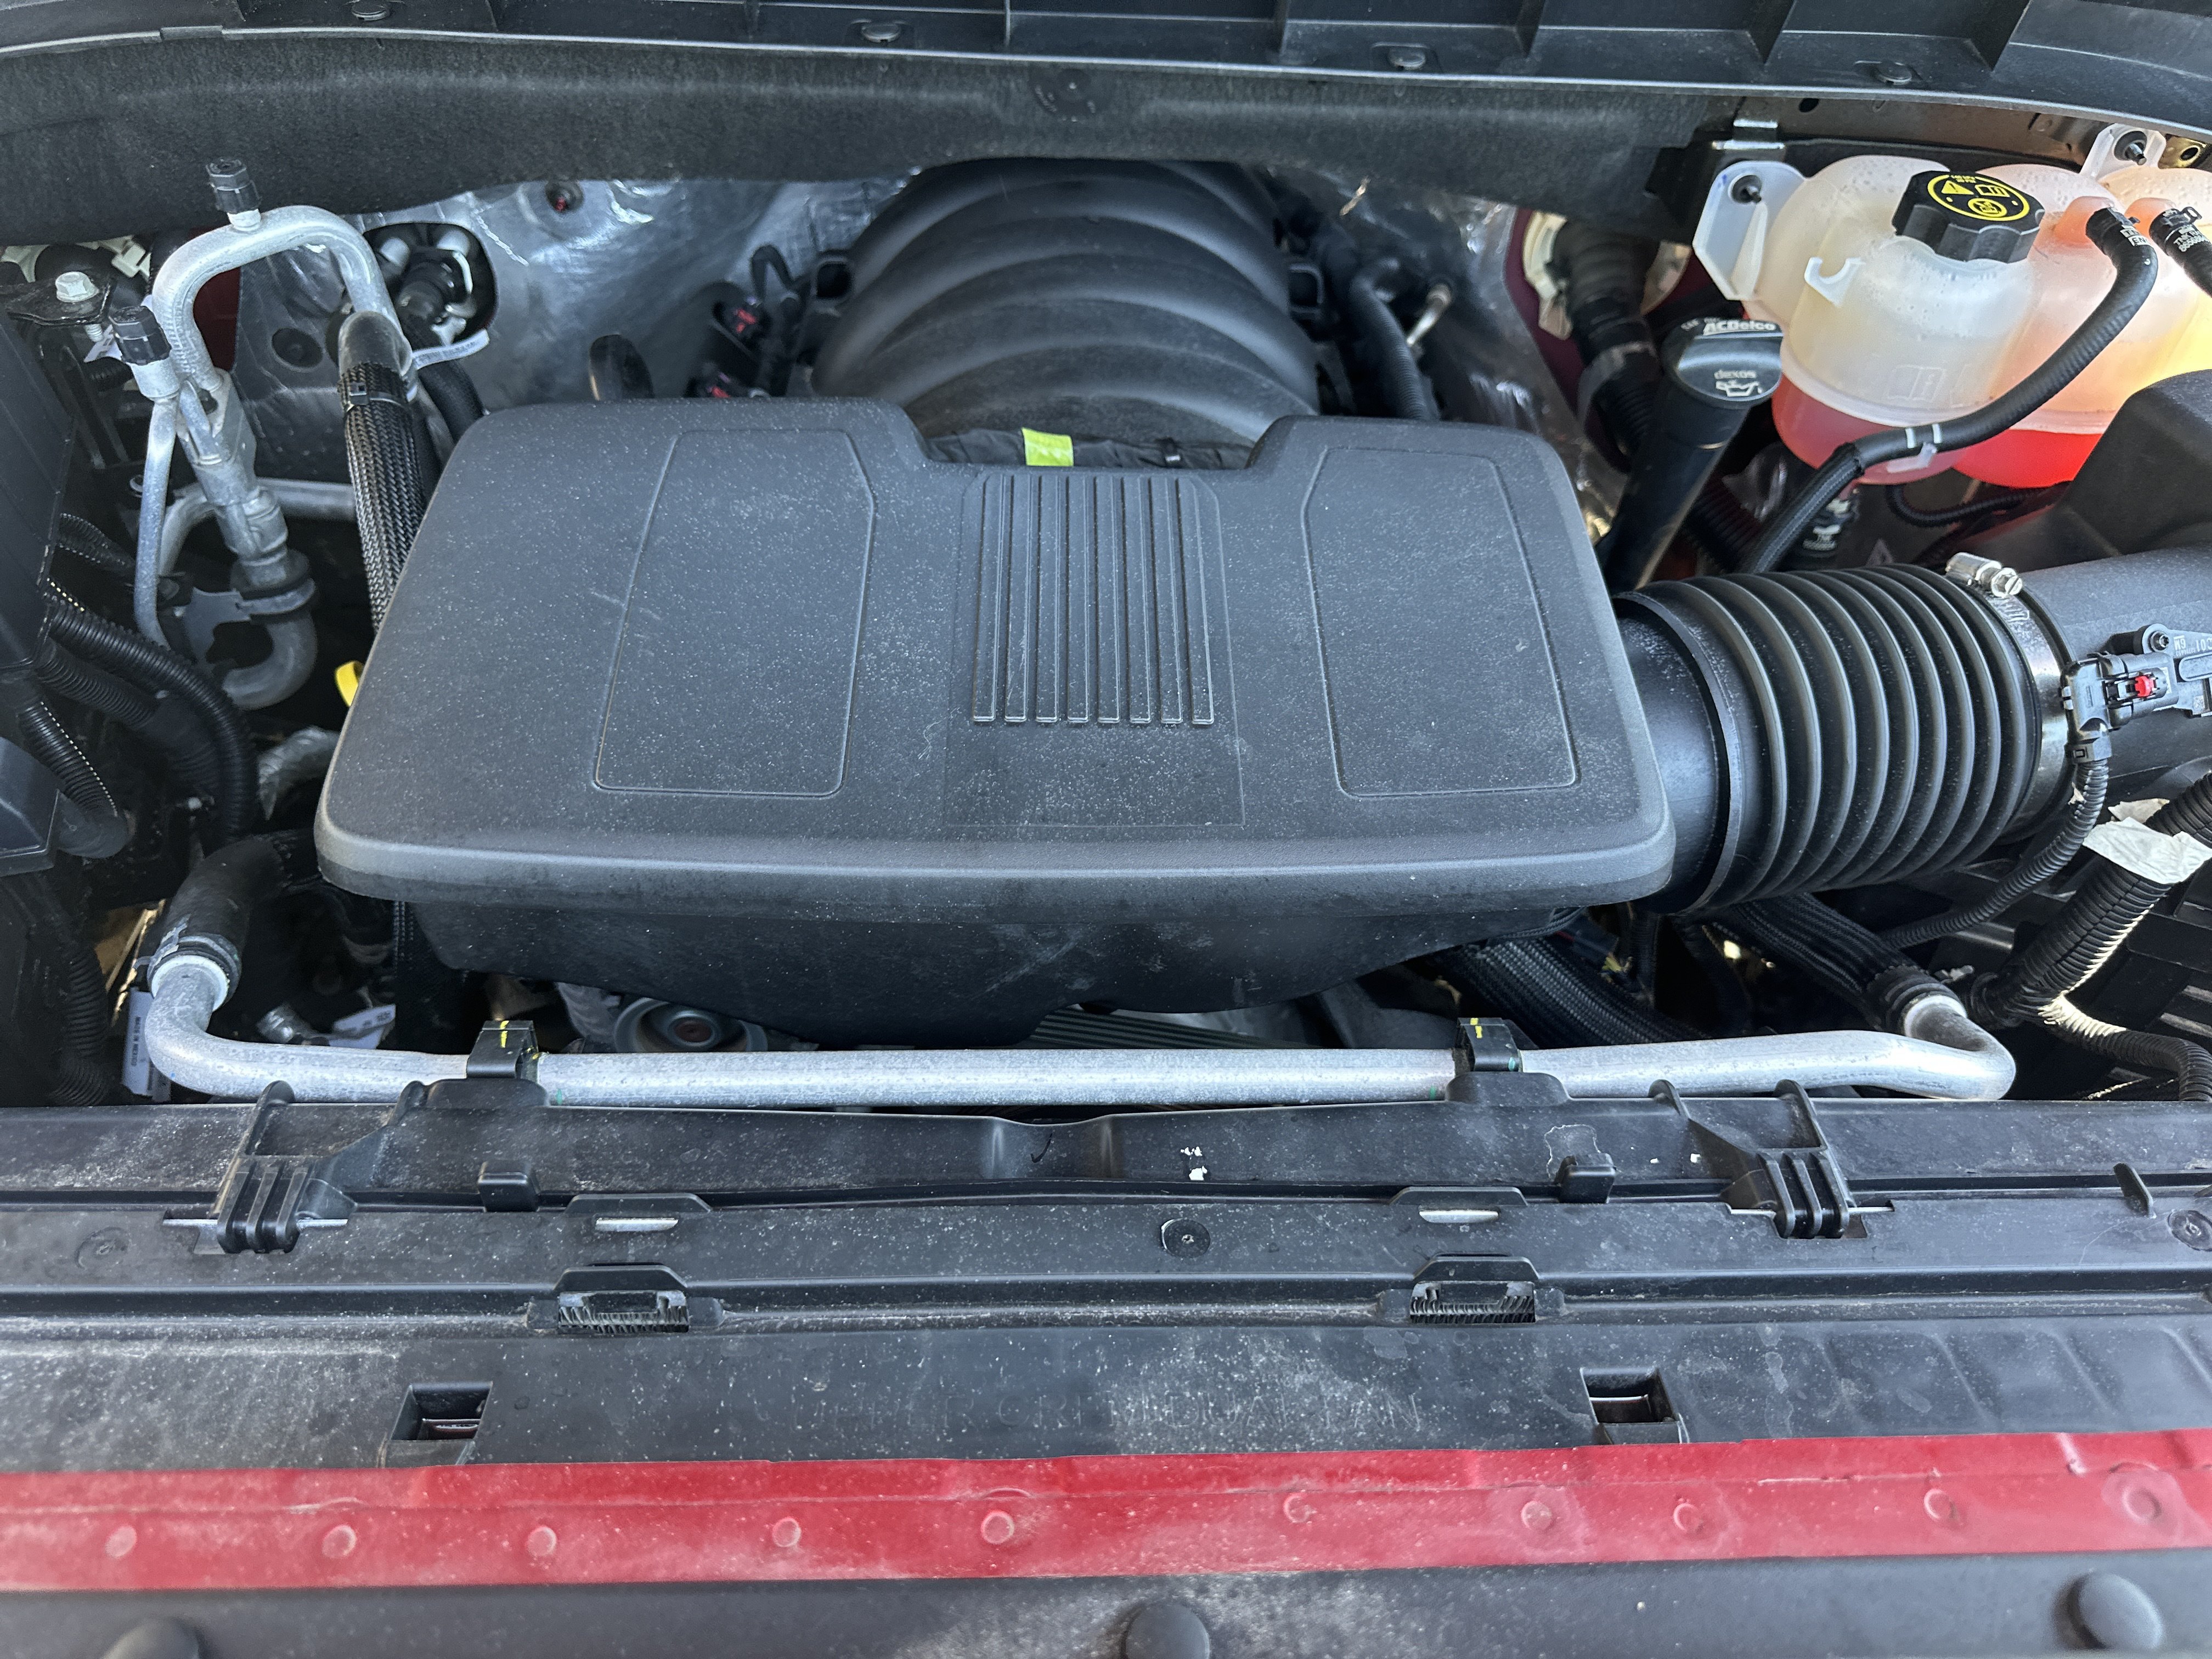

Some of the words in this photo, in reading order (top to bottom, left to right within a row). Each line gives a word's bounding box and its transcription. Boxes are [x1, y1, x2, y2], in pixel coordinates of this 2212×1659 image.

[1703, 319, 1776, 336] ACDelco
[1713, 369, 1757, 380] dexos
[2174, 637, 2186, 650] GM
